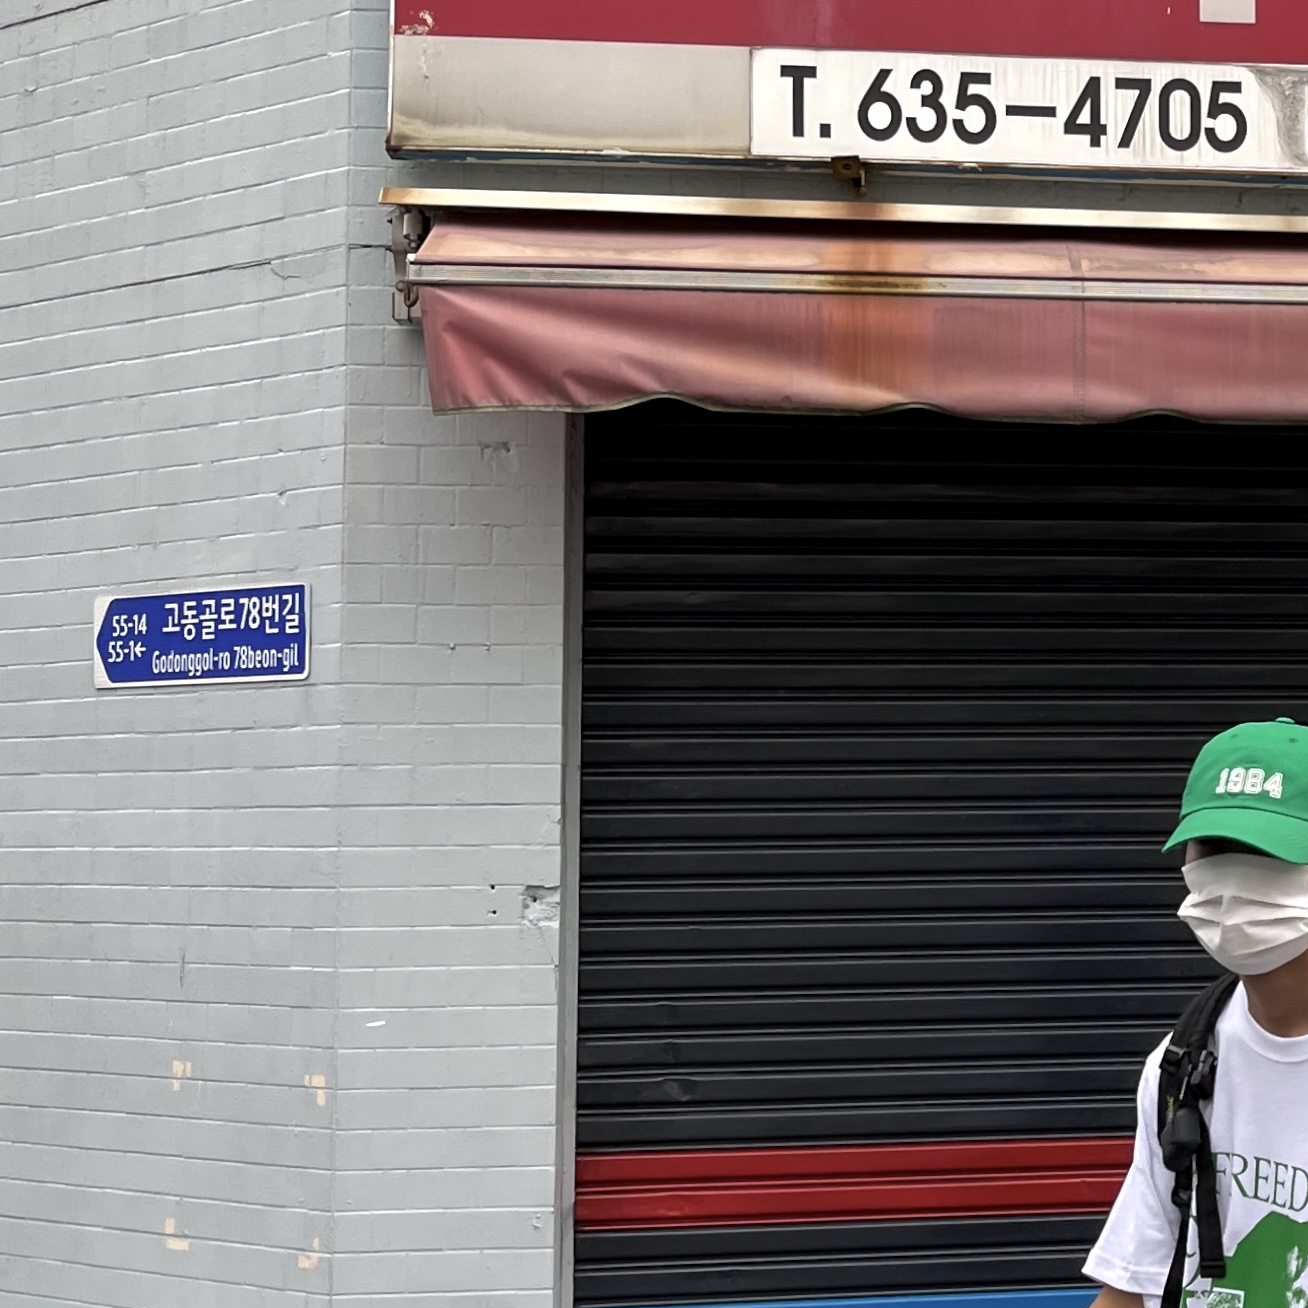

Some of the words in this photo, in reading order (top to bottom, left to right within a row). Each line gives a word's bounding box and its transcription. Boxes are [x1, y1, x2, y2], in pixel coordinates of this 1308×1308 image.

[780, 65, 832, 139] T.
[857, 68, 1249, 154] 635-4705
[112, 613, 148, 637] 55-14
[161, 592, 300, 641] 고동골로78번길
[107, 640, 135, 663] 55-1
[152, 646, 231, 677] Godonggol-ro
[233, 643, 299, 673] 78beon-gil
[1215, 767, 1284, 799] 1984
